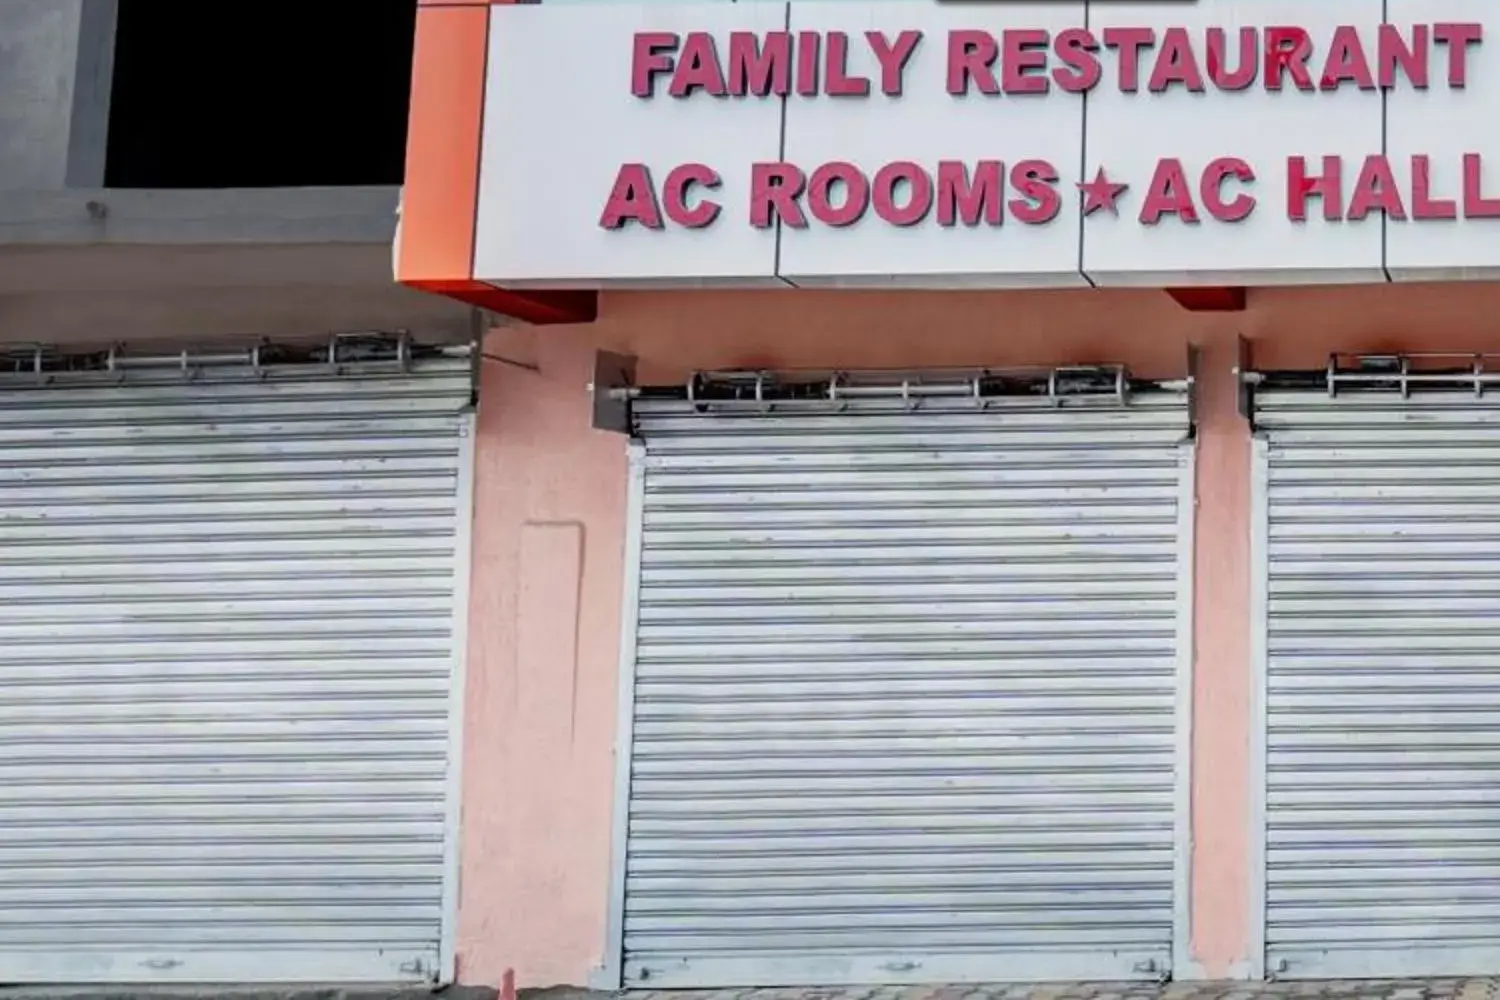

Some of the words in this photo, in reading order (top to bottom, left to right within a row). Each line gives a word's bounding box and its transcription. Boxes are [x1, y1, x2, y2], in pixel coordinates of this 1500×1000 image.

[630, 29, 922, 98] FAMILY
[945, 22, 1484, 93] RESTAURANT
[600, 163, 722, 229] AC
[748, 159, 1062, 228] ROOMS
[1137, 156, 1256, 224] AC
